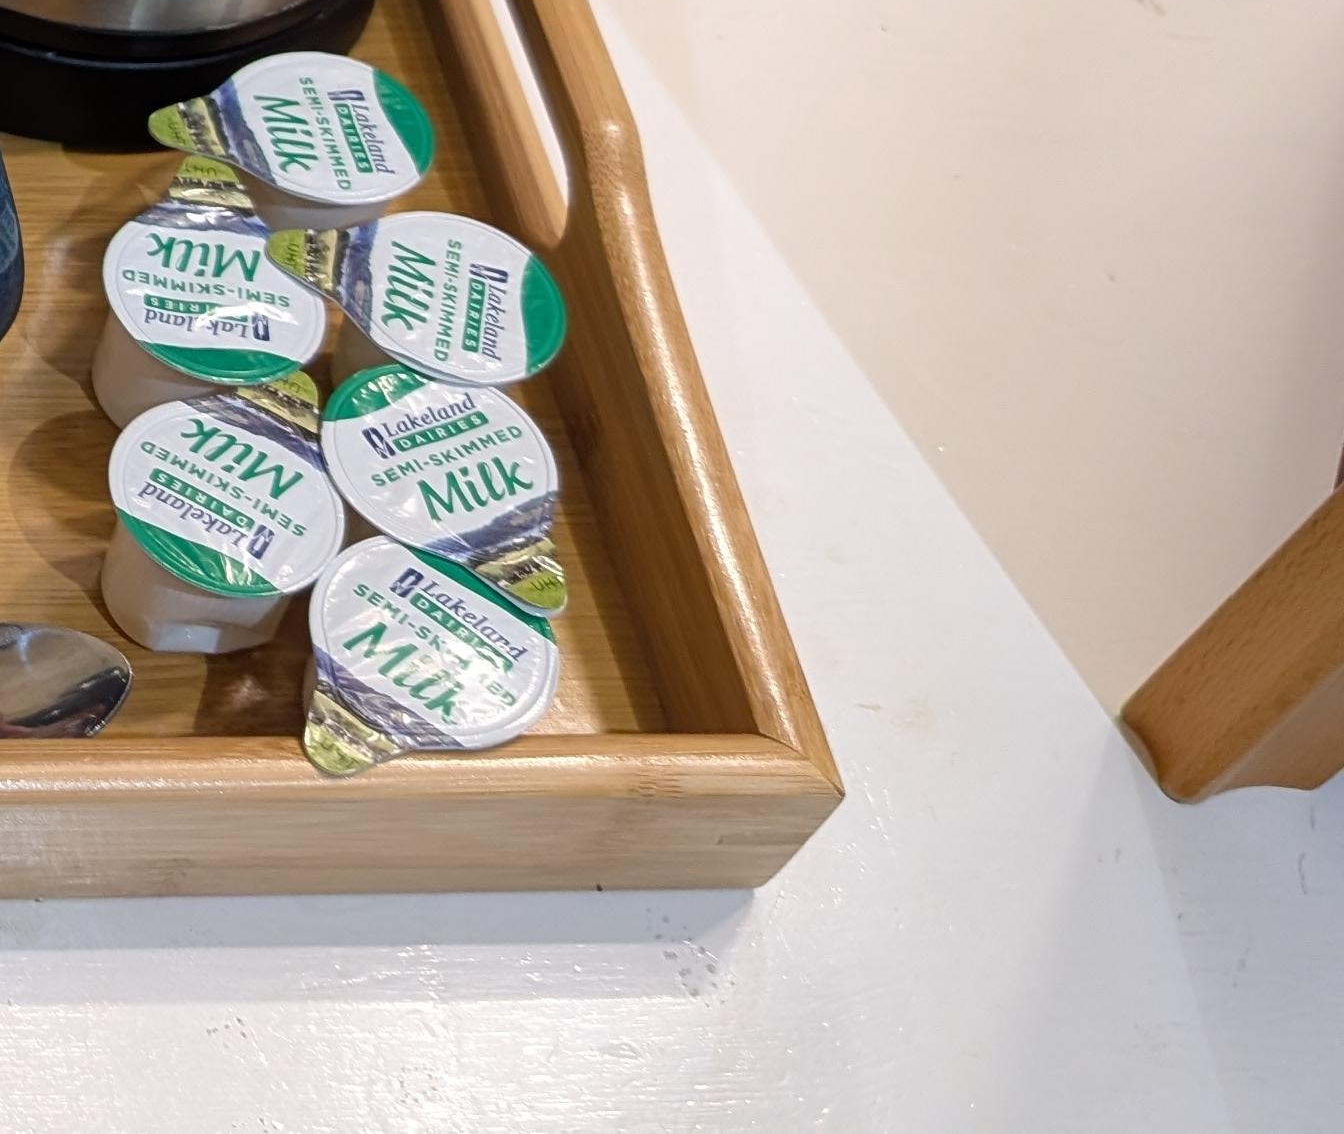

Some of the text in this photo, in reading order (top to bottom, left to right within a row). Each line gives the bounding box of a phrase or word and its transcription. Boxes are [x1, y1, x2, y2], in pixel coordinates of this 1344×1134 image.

[253, 94, 319, 173] Milk
[300, 77, 352, 191] SEMI-SKIMMED
[337, 106, 371, 172] DAIRIES
[352, 99, 395, 175] Lakeland
[123, 269, 291, 308] SEMI-SKIMMED
[145, 233, 261, 282] Milk
[381, 241, 437, 330] Milk
[434, 239, 463, 361] SEMI-SKIMMED
[464, 280, 485, 349] DAIRIES
[481, 283, 508, 362] Lakeland
[381, 392, 476, 438] Lakeland
[399, 415, 483, 448] DAIRIES
[140, 441, 308, 537] SEMI-SKIMMED
[180, 418, 304, 501] Milk
[371, 425, 523, 487] SEMI-SKIMMED
[417, 456, 534, 522] Milk
[137, 481, 249, 547] Lakeland
[156, 473, 248, 528] DAIRIES
